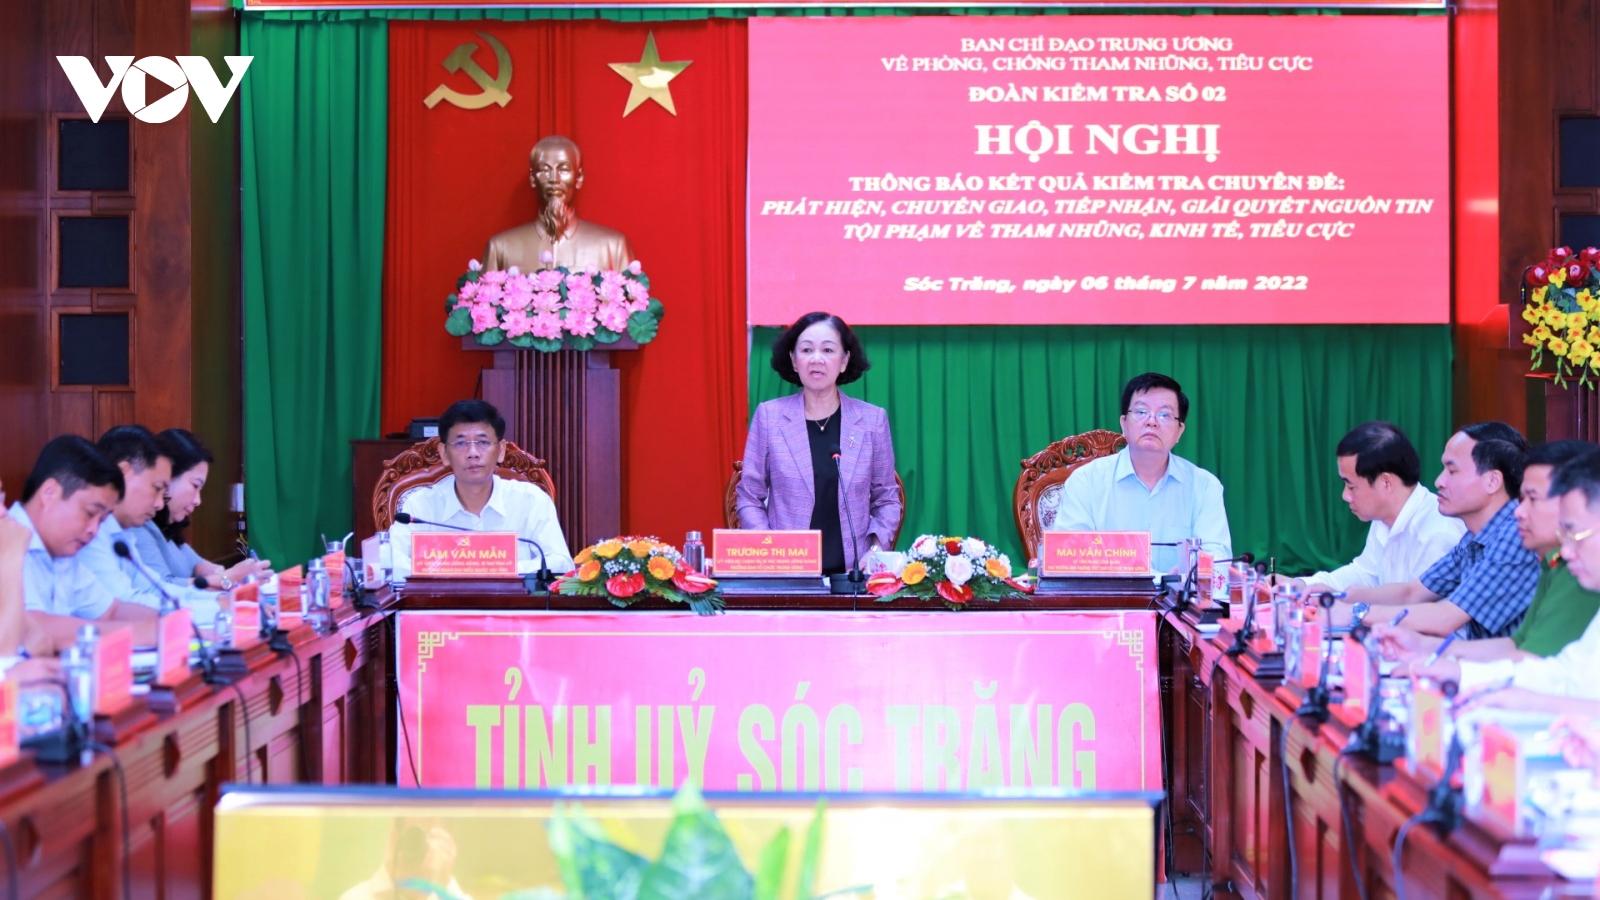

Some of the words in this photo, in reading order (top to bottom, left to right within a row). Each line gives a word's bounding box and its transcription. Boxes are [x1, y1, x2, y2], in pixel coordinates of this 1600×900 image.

[960, 38, 1006, 53] BAN
[1049, 38, 1095, 54] ĐẠO
[1097, 38, 1168, 52] TRUNG
[1172, 36, 1234, 52] ƯƠNG
[911, 55, 989, 72] PHÒNG,
[1070, 56, 1131, 71] THAM
[1217, 54, 1263, 70] TIÊU
[1267, 55, 1313, 73] CỰC
[968, 83, 1039, 102] ĐOÀN
[1111, 86, 1163, 102] TRA
[1202, 86, 1227, 102] 02
[974, 120, 1074, 163] HỘI
[1085, 124, 1221, 163] NGHỊ
[849, 172, 932, 192] THÔNG
[935, 172, 984, 191] BÁO
[1038, 172, 1089, 194] QUẢ
[1158, 175, 1205, 191] TRA
[1208, 171, 1303, 191] CHUYÊN
[760, 197, 824, 215] PHÁT
[824, 199, 887, 218] HIỆN,
[987, 199, 1049, 216] GIAO,
[1395, 198, 1434, 214] TIN
[843, 223, 882, 242] TỘI
[883, 223, 952, 242] PHẠM
[990, 223, 1057, 239] THAM
[1148, 223, 1209, 238] KINH
[1249, 219, 1303, 238] TIÊU
[1305, 221, 1356, 241] CỰC
[903, 275, 944, 292] Sóc
[948, 276, 1017, 294] Trăng,
[1022, 276, 1078, 294] ngày
[1081, 276, 1109, 291] 06
[1114, 275, 1178, 294] tháng
[1182, 276, 1198, 291] 7
[1201, 275, 1248, 291] năm
[1253, 276, 1309, 291] 2022
[424, 548, 447, 559] LÂM
[727, 547, 768, 557] TRƯƠNG
[771, 548, 785, 558] THỊ
[788, 548, 808, 557] MAI
[1057, 548, 1076, 557] MAI
[1080, 547, 1101, 556] VĂN
[1105, 547, 1137, 557] CHÍNH
[467, 668, 611, 787] TỈNH
[737, 681, 862, 790] SÓC
[886, 680, 1096, 791] TRĂNG
